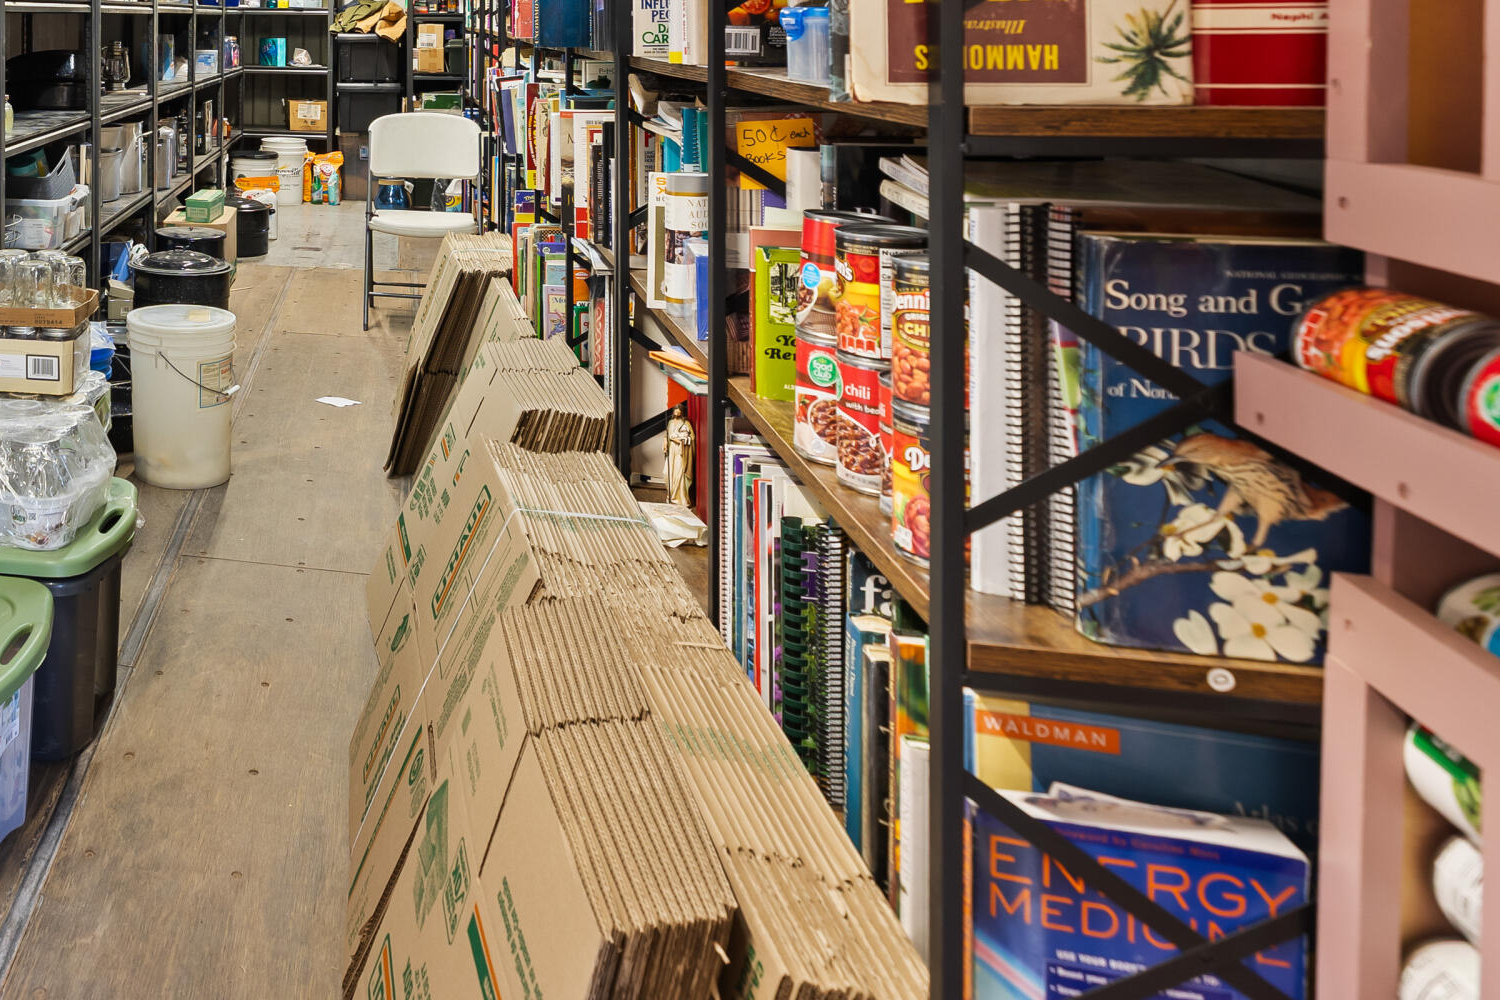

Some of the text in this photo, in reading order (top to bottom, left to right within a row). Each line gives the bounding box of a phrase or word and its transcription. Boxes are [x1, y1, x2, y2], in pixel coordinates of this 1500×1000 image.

[963, 18, 1027, 34] Illustra
[914, 44, 1059, 71] HAMMOS
[789, 127, 811, 140] each
[1105, 279, 1188, 318] Song
[1198, 288, 1259, 315] and
[812, 359, 833, 372] food
[812, 369, 833, 382] club
[844, 383, 871, 401] chili
[1107, 377, 1180, 401] of Nor
[845, 400, 863, 412] with
[982, 714, 1108, 748] WALDMAN
[989, 833, 1297, 920] ENRGY
[989, 881, 1293, 969] MEDIC
